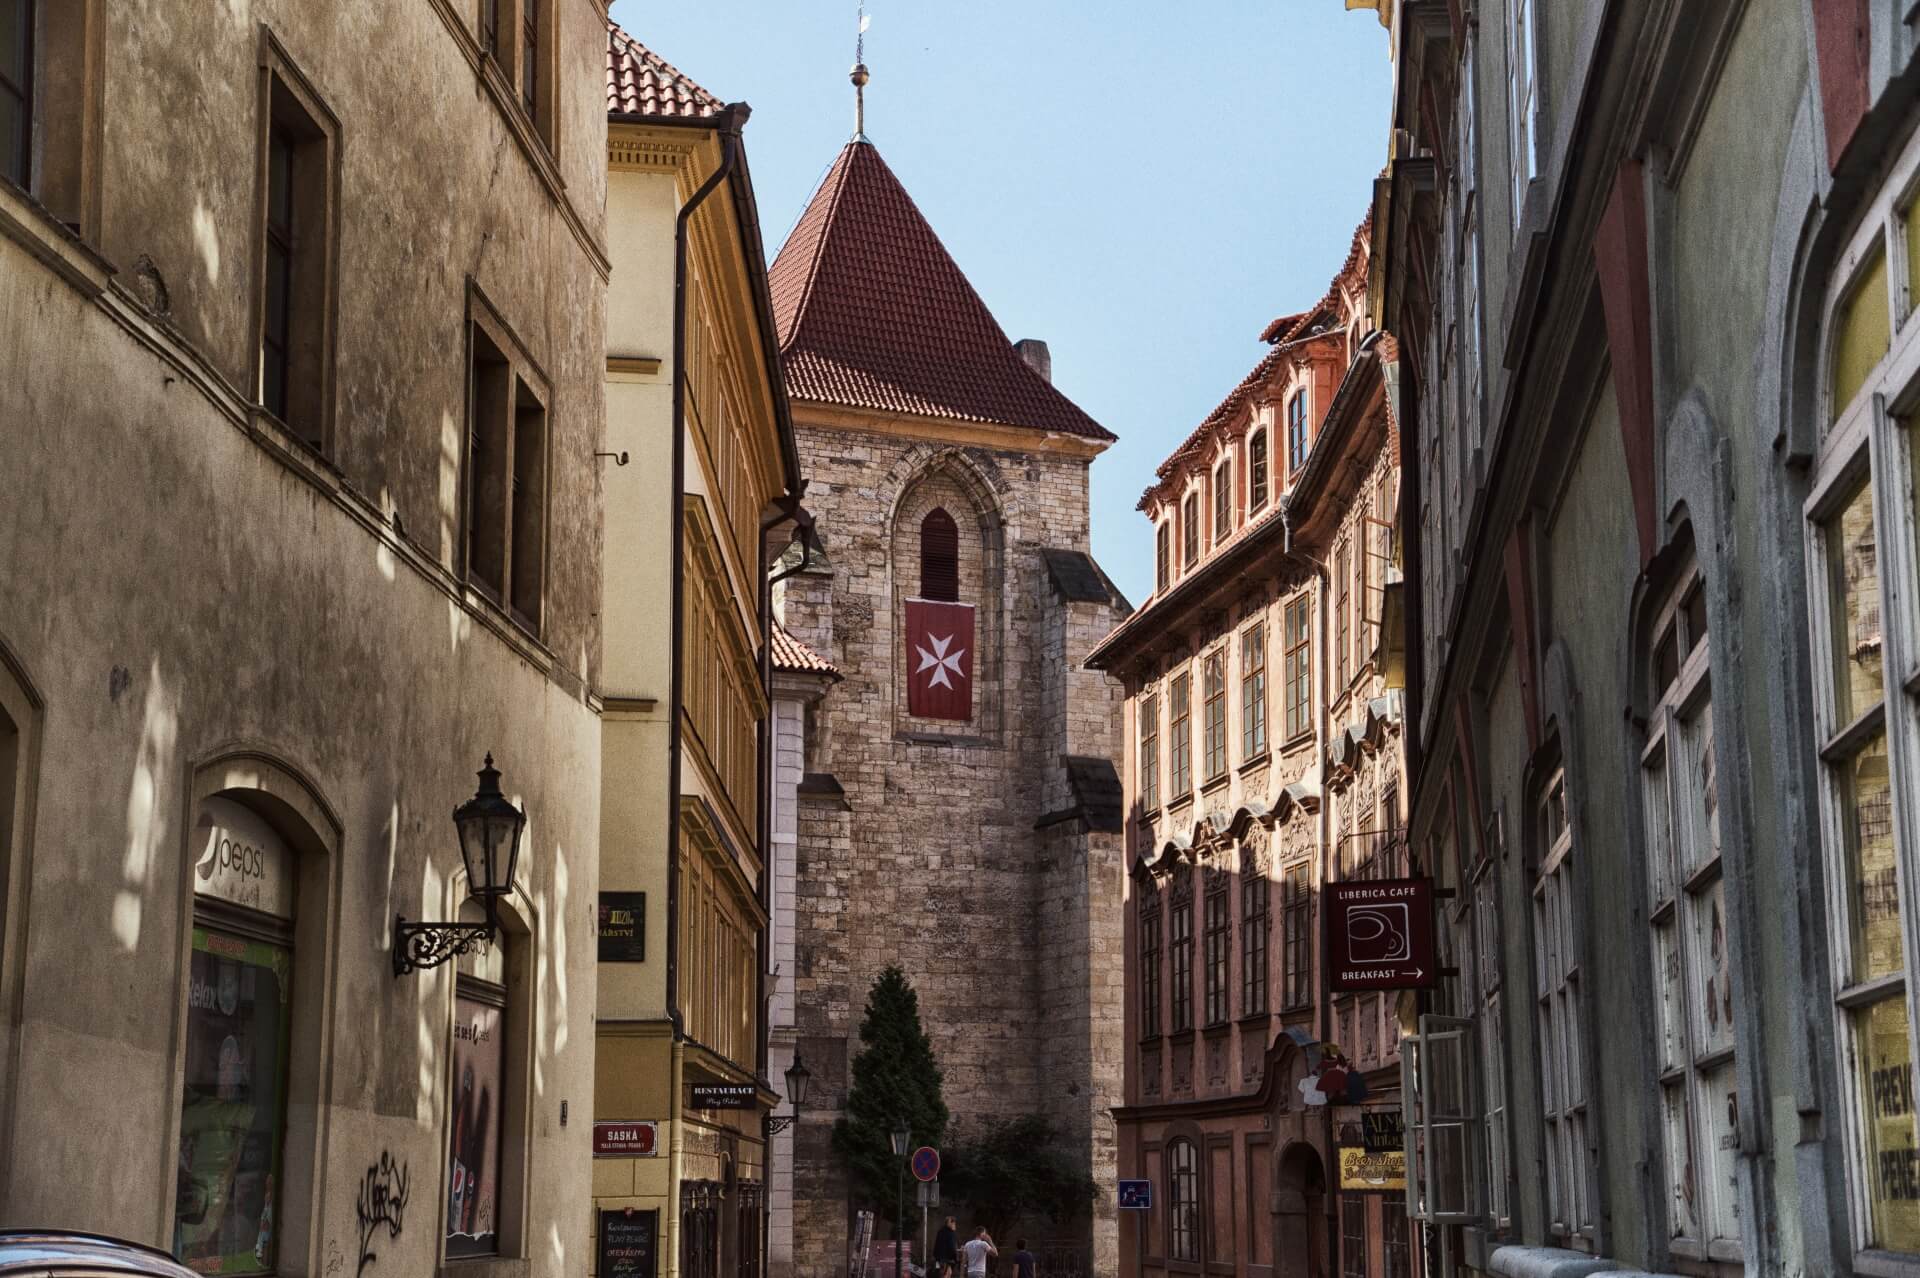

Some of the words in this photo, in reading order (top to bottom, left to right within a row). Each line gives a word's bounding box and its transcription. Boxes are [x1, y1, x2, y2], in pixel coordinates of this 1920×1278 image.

[219, 838, 265, 882] pepsi
[1339, 888, 1386, 899] LIBERICA
[1390, 887, 1416, 897] CAFE
[1341, 969, 1396, 980] BREAKFAST
[694, 1087, 755, 1095] RESTAURACE
[1344, 1152, 1371, 1167] Beer
